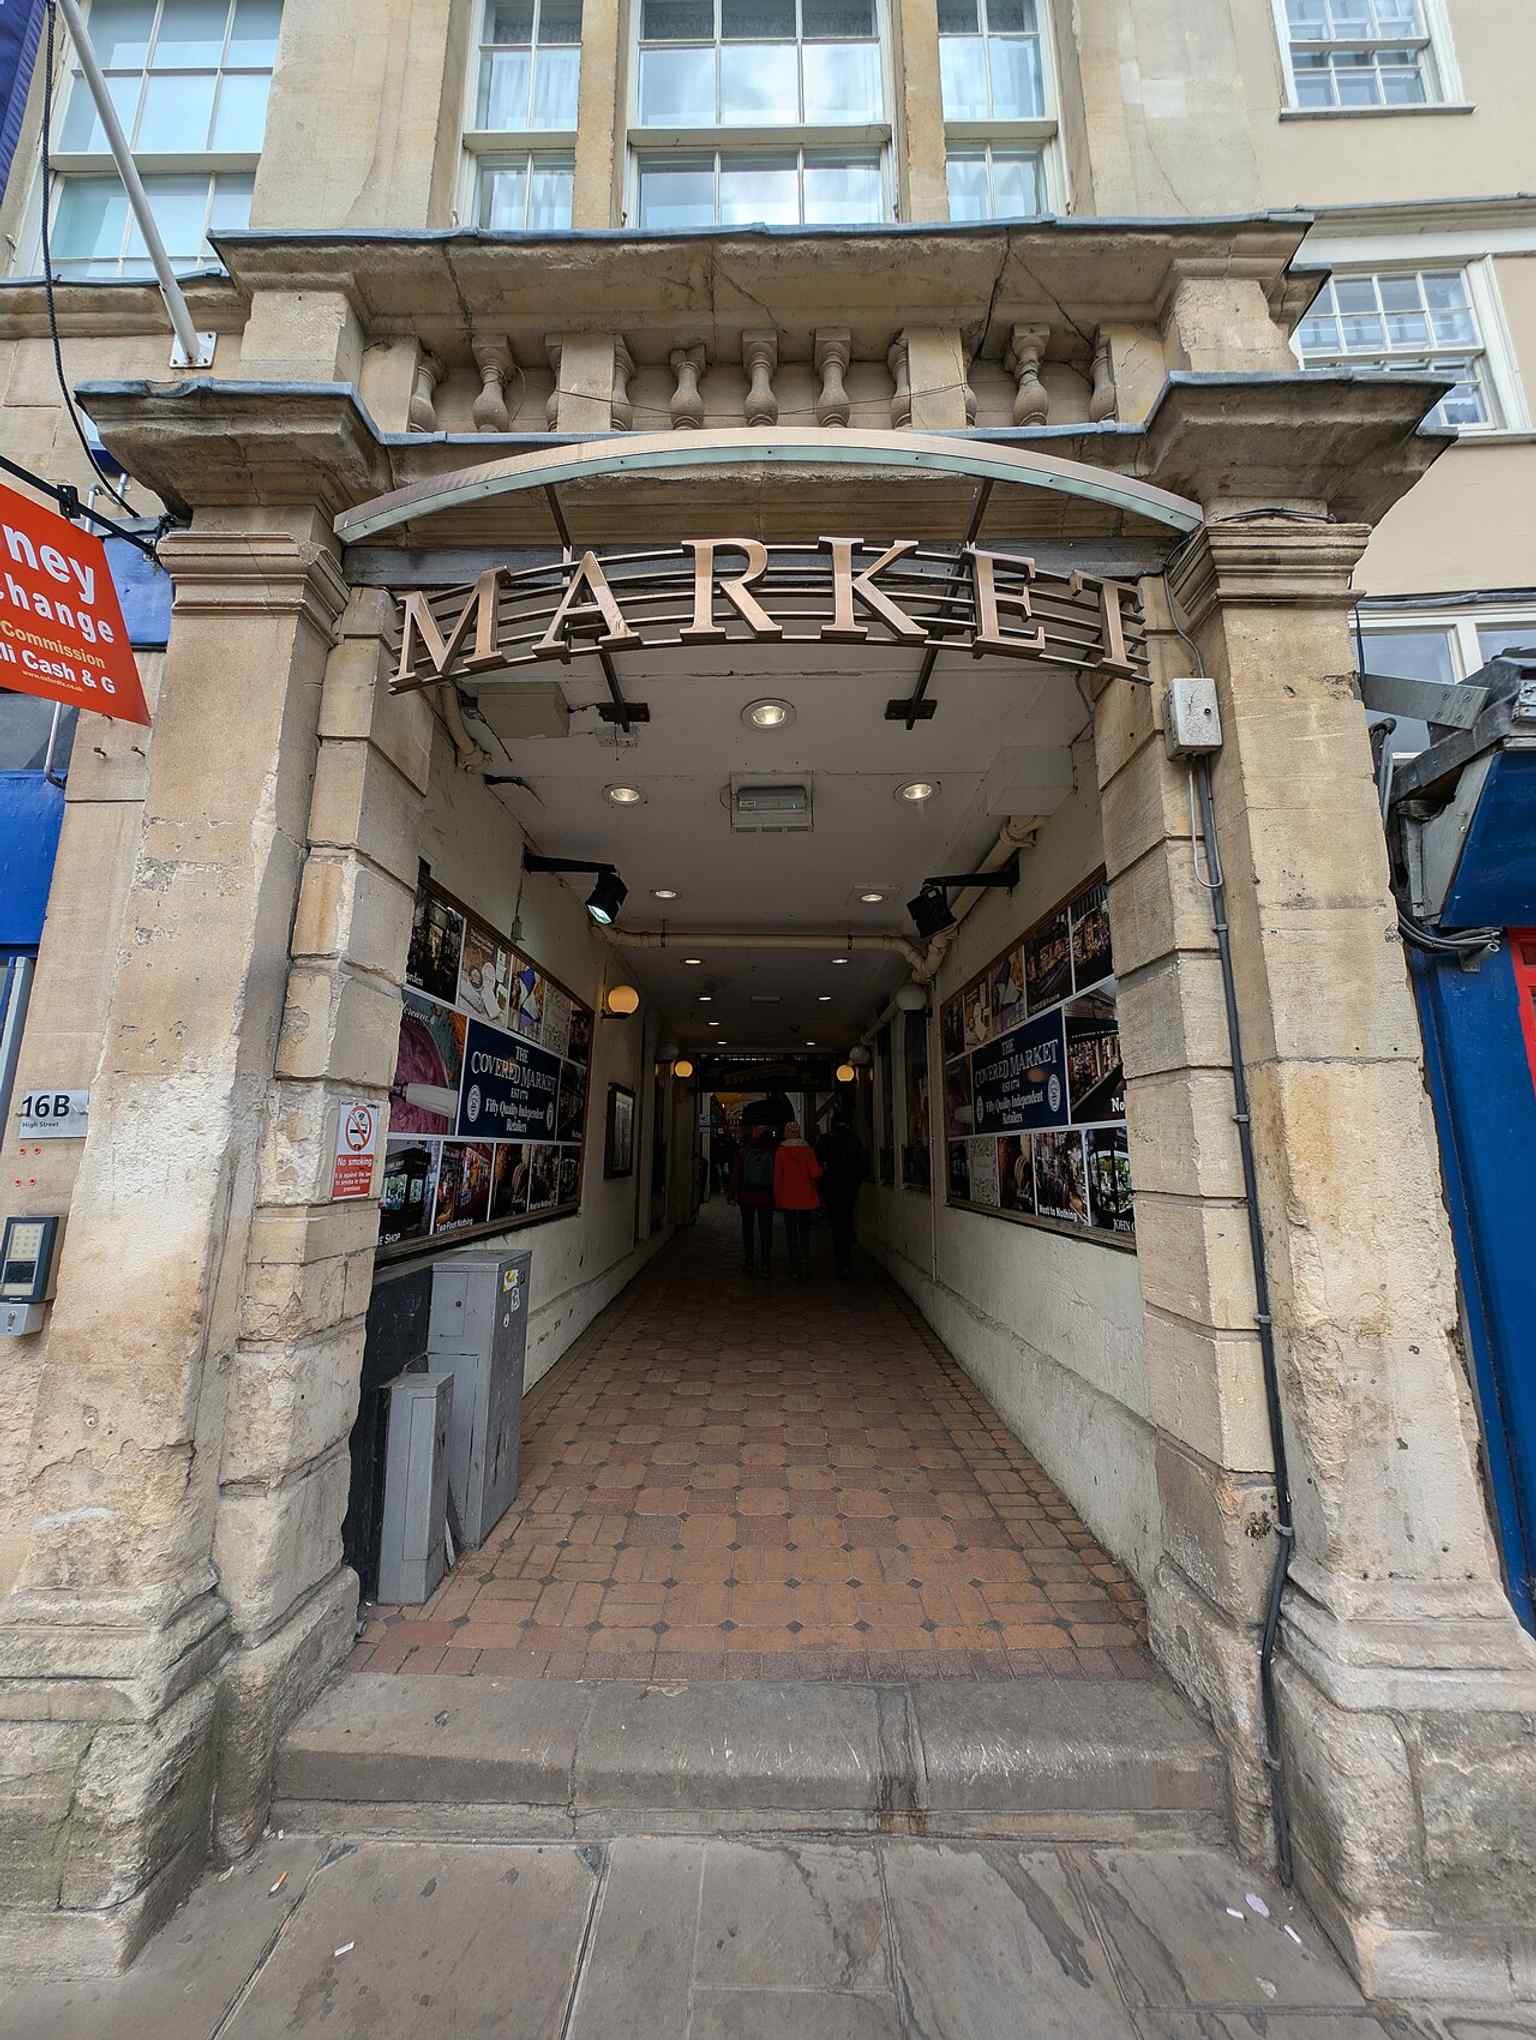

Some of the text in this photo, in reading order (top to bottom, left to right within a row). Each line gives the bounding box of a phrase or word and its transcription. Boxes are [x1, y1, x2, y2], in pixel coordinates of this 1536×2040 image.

[0, 572, 115, 645] hange
[388, 536, 1146, 691] MARKET
[0, 620, 106, 669] Commission
[21, 649, 77, 682] Cash
[81, 669, 97, 688] &
[101, 676, 116, 694] G
[471, 1051, 558, 1096] COVERED MARKET
[514, 1045, 529, 1064] THE
[1009, 1038, 1059, 1077] MARKET
[22, 1094, 71, 1118] 16B
[518, 1103, 545, 1120] Independent
[1011, 1089, 1043, 1109] Independent
[22, 1120, 59, 1129] High Street
